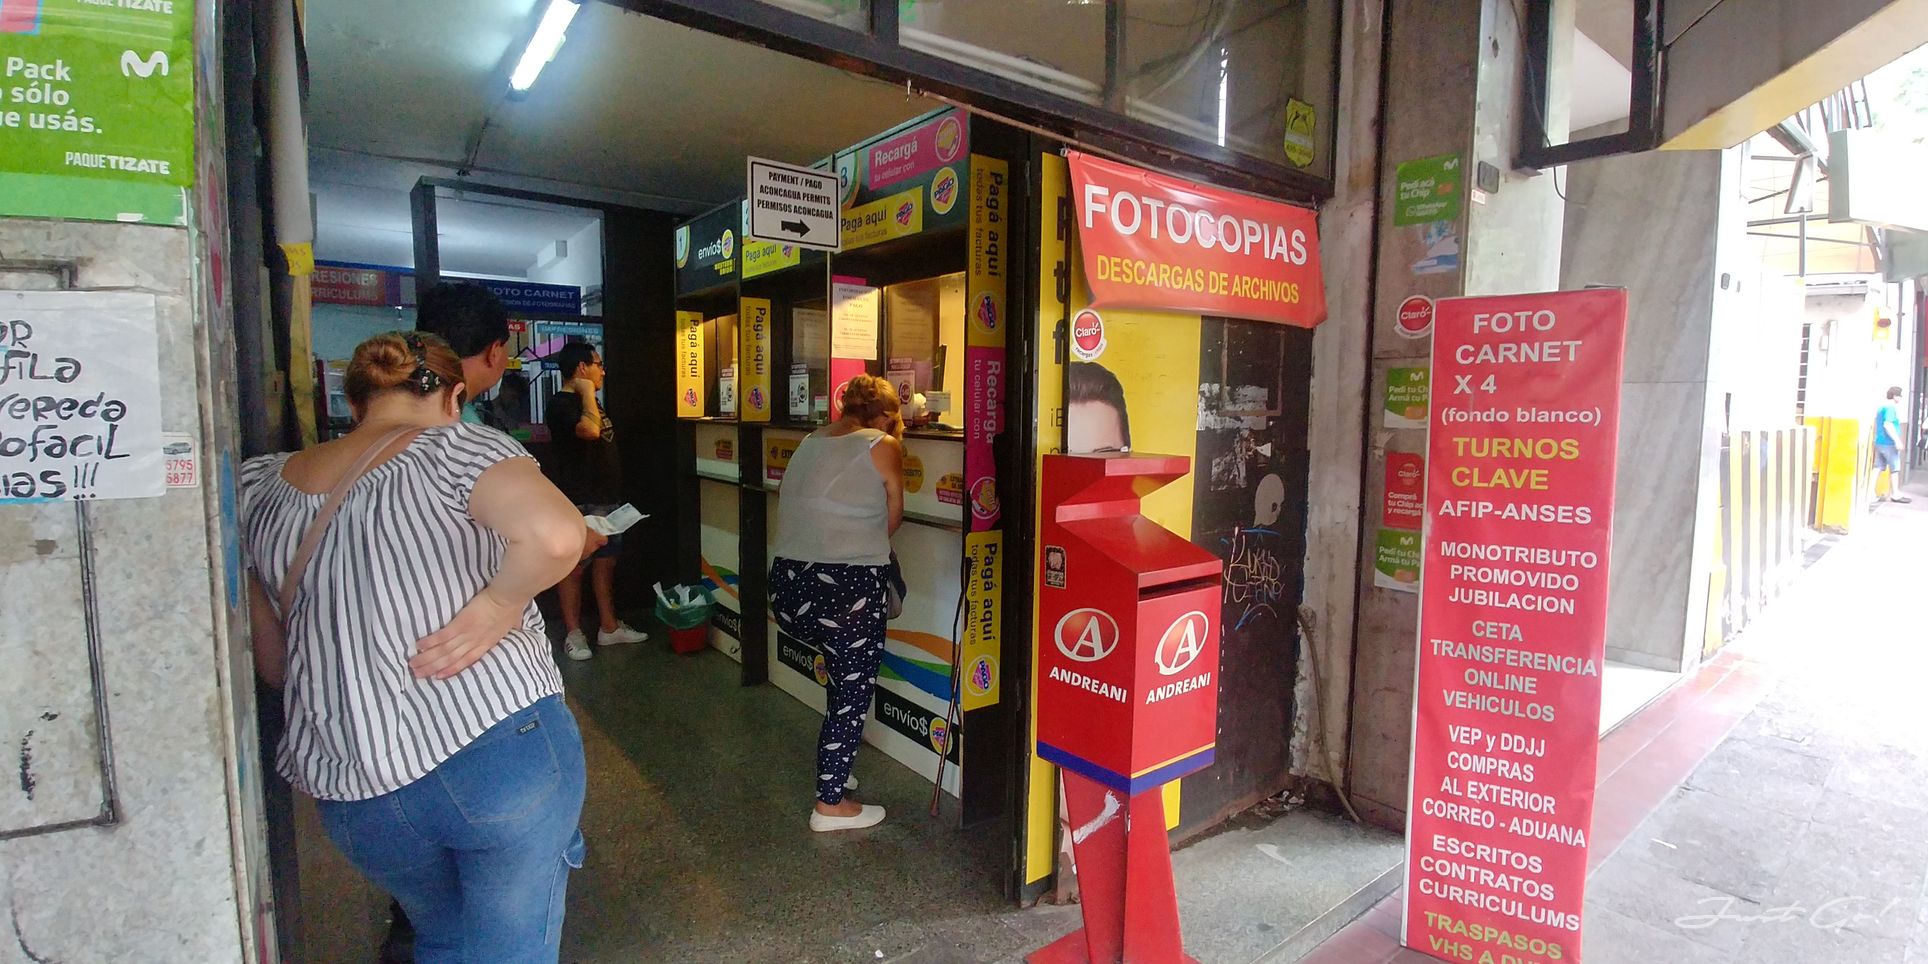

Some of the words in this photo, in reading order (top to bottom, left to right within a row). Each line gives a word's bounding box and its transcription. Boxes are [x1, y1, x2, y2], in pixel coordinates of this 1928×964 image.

[6, 56, 71, 81] Pack
[11, 80, 70, 106] sólo
[0, 111, 20, 127] e
[29, 108, 103, 134] usás.
[65, 151, 170, 175] PAQUETIZATE
[874, 136, 918, 167] Recargá
[768, 171, 799, 185] PAYMENT
[805, 178, 823, 190] PAGO
[759, 184, 801, 201] ACONCAGUA
[802, 192, 831, 205] PERMITS
[985, 171, 1003, 223] Pagá
[757, 198, 793, 213] PERMISOS
[793, 205, 834, 220] ACONCAGUA
[1084, 184, 1308, 265] FOTOCOPIAS
[985, 230, 1001, 277] aquí
[311, 271, 378, 287] RESIONES
[1097, 255, 1205, 293] DESCARGAS
[1208, 270, 1229, 295] DE
[1231, 274, 1299, 304] ARCHIVOS
[524, 289, 575, 299] CARNET
[1401, 305, 1431, 321] Claro
[1473, 309, 1556, 334] FOTO
[1076, 323, 1100, 338] Claro
[974, 359, 981, 372] tu
[1455, 340, 1583, 365] CARNET
[973, 374, 982, 414] celular
[1453, 374, 1472, 395] X
[1480, 374, 1497, 394] 4
[973, 417, 981, 439] con
[1441, 407, 1509, 426] (fondo
[1516, 407, 1601, 426] blanco)
[1453, 437, 1580, 460] TURNOS
[1451, 466, 1549, 490] CLAVE
[1439, 500, 1592, 525] AFIP-ANSES
[970, 544, 979, 577] todas
[980, 542, 998, 592] Pagá
[1441, 540, 1598, 569] MONOTRIBUTO
[970, 579, 979, 596] tus
[1450, 564, 1579, 591] PROMOVIDO
[1449, 587, 1575, 615] JUBILACION
[970, 600, 979, 646] facturas
[979, 598, 996, 641] aquí
[1472, 620, 1523, 642] CETA
[1430, 639, 1598, 677] TRANSFERENCIA
[1049, 666, 1128, 704] ANDREANI
[1145, 672, 1212, 705] ANDREANI
[1464, 668, 1537, 695] ONLINE
[1442, 689, 1555, 722] VEHICULOS
[883, 702, 928, 737] envío$
[1448, 724, 1481, 745] VEP
[1486, 733, 1496, 753] y
[1500, 732, 1545, 757] DDJJ
[1447, 751, 1534, 783] COMPRAS
[1440, 776, 1463, 797] AL
[1467, 780, 1556, 815] EXTERIOR
[1422, 797, 1495, 829] CORREO
[1508, 816, 1587, 849] ADUANA
[1433, 834, 1543, 874] ESCRITOS
[1420, 856, 1555, 901] CONTRATOS
[1419, 878, 1580, 932] CURRICULUMS
[1424, 911, 1563, 960] TRASPASOS
[1428, 934, 1473, 961] VHS
